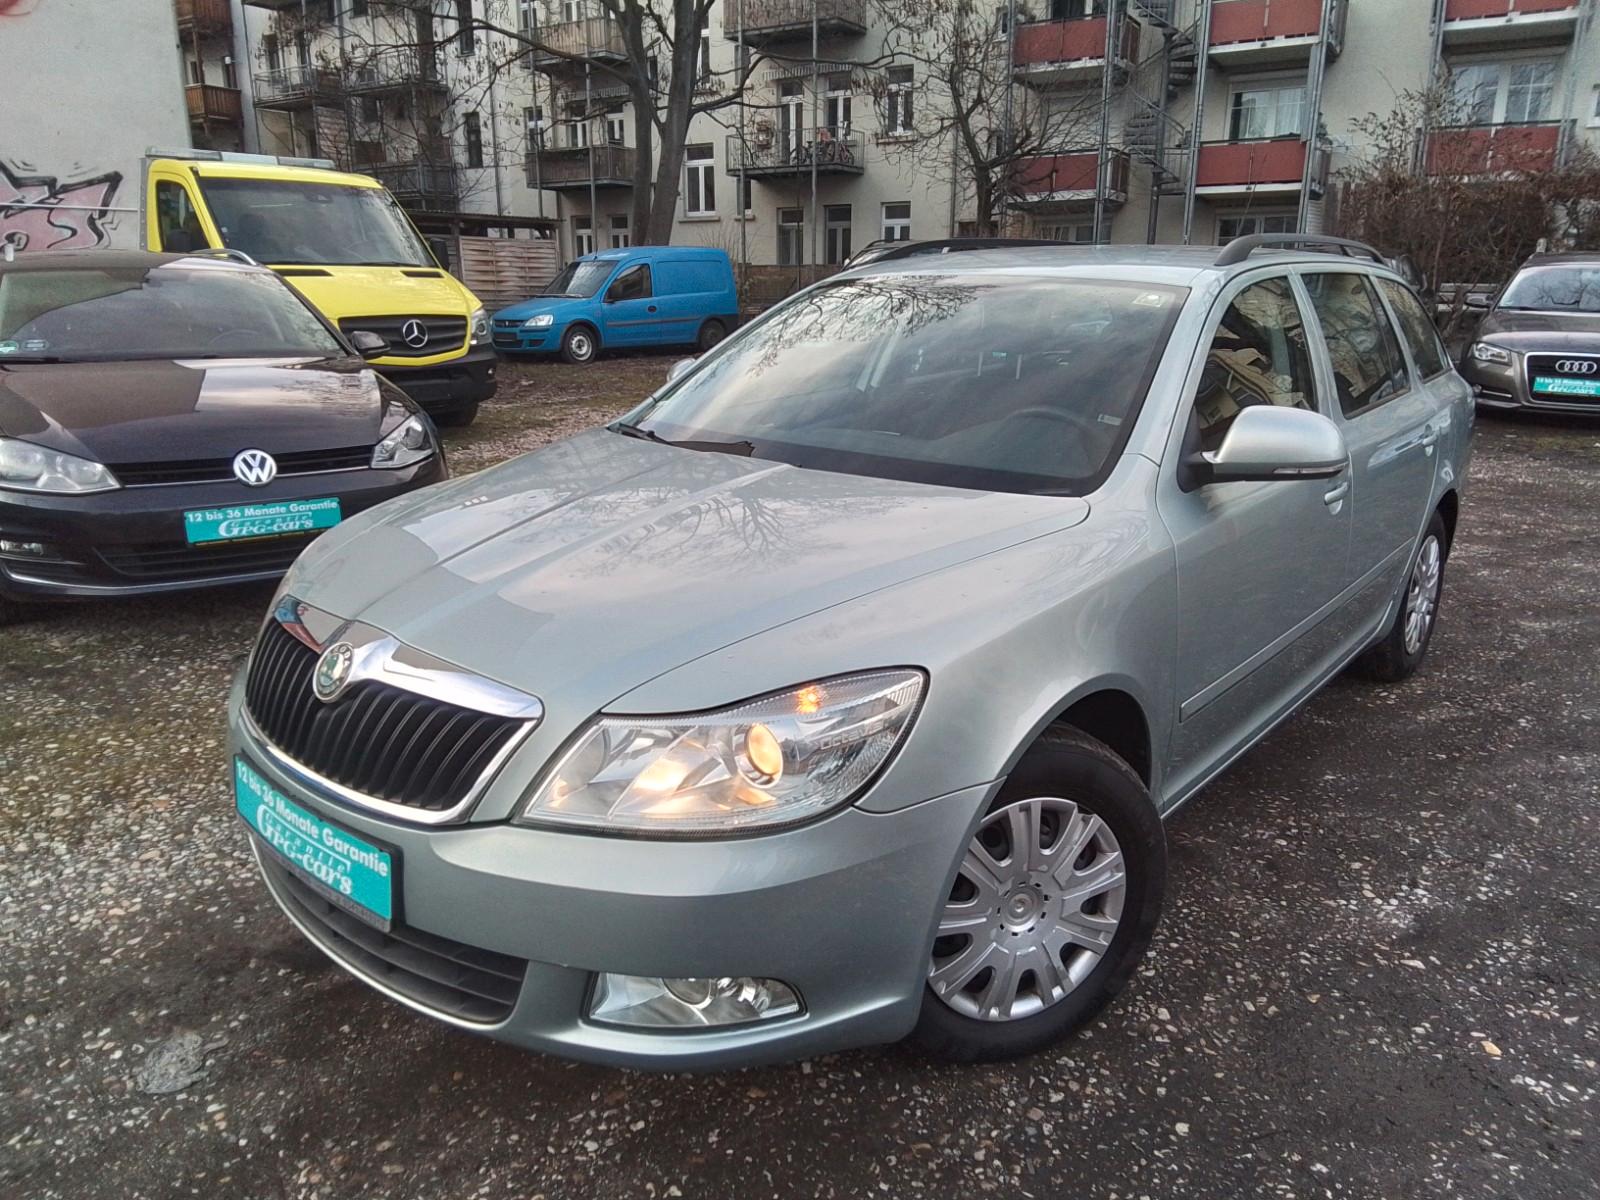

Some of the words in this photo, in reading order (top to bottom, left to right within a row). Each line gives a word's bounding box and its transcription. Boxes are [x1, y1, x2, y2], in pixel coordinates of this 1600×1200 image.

[188, 512, 203, 522] 12
[205, 511, 224, 521] bis
[226, 509, 241, 519] 36
[244, 505, 287, 518] Monate
[288, 500, 338, 513] Garantie
[236, 761, 248, 784] 12
[248, 770, 261, 796] bis
[261, 785, 275, 807] 36
[275, 796, 319, 839] Monate
[322, 827, 388, 877] Garantie
